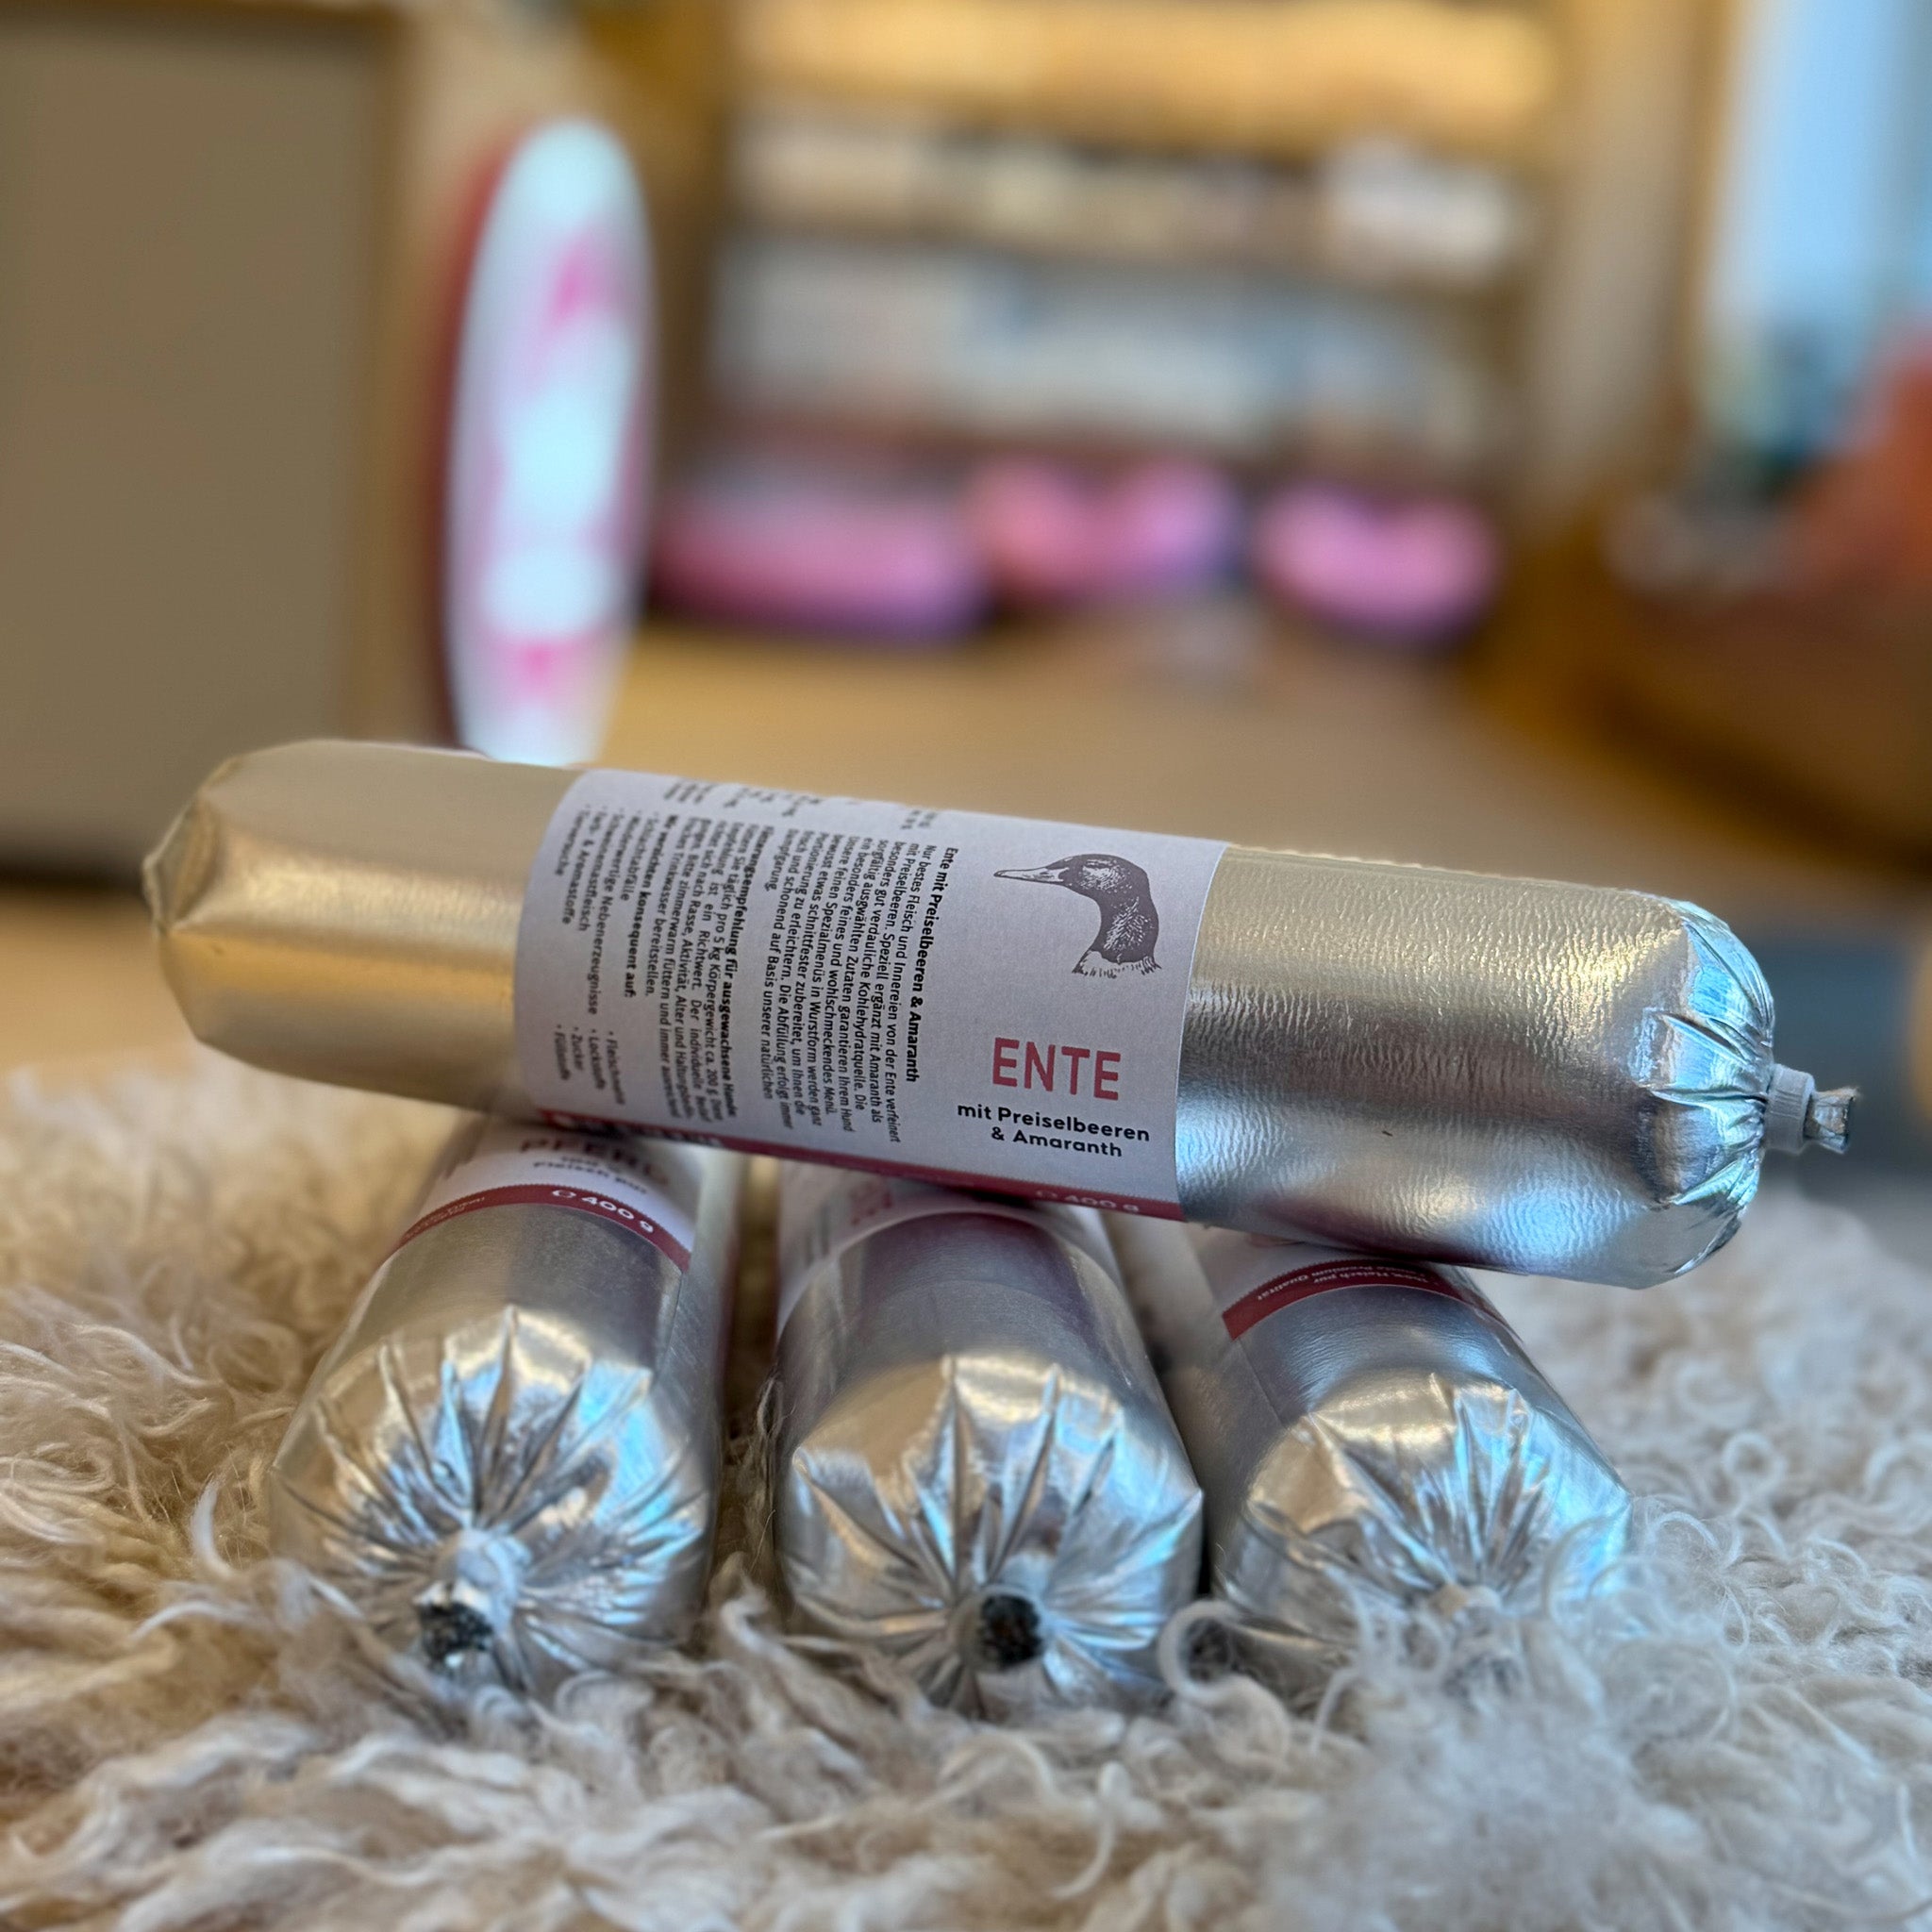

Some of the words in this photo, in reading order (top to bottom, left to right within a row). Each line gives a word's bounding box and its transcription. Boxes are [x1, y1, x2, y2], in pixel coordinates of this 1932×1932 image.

[641, 832, 668, 889] verzichten
[700, 849, 714, 870] sich
[839, 837, 859, 865] Unsere
[860, 838, 873, 850] ein
[863, 840, 889, 880] sorgfältig
[906, 843, 921, 857] mit
[922, 845, 937, 860] Nur
[940, 847, 958, 870] Ente
[731, 857, 746, 872] Sie
[788, 855, 802, 874] und
[794, 833, 829, 895] Portionierung
[843, 852, 873, 903] besonders
[879, 841, 907, 887] besonders
[910, 861, 931, 892] bestes
[932, 872, 948, 891] mit
[562, 850, 590, 924] Aromastoffe
[658, 853, 684, 915] Trinkwasser
[692, 872, 708, 897] nach
[708, 882, 724, 895] ist
[720, 874, 740, 910] täglich
[811, 871, 828, 901] etwas
[828, 867, 848, 899] feinen
[874, 889, 887, 907] gut
[884, 858, 916, 930] Preiselbeeren.
[665, 880, 690, 955] zimmerwarm
[681, 900, 702, 936] Rasse,
[702, 904, 717, 922] ein
[774, 876, 797, 930] schonend
[793, 897, 805, 909] zu
[848, 882, 874, 952] ausgwählten
[900, 894, 921, 932] Fleisch
[626, 891, 652, 970] konsequent
[715, 912, 727, 934] pro
[834, 906, 854, 941] feines
[587, 895, 614, 1015] Nebenerzeugnisse
[645, 918, 667, 996] bereitstellen.
[708, 946, 726, 961] kg
[769, 933, 781, 954] auf
[780, 912, 802, 980] erleichtern.
[797, 904, 820, 979] schnittfester
[812, 902, 838, 983] Spezialmenüs
[830, 943, 842, 967] und
[860, 909, 882, 978] verdauliche
[875, 933, 895, 980] Speziell
[895, 936, 908, 959] und
[912, 894, 942, 991] Preiselbeeren
[674, 939, 693, 992] Aktivität,
[691, 930, 710, 991] Richtwert.
[724, 958, 738, 979] für
[764, 956, 780, 988] Basis
[625, 973, 637, 997] auf:
[660, 958, 676, 999] füttern
[778, 985, 791, 1005] Die
[810, 986, 824, 998] in
[841, 956, 859, 1002] Zutaten
[888, 962, 906, 1020] Innereien
[659, 1003, 672, 1026] und
[675, 995, 687, 1024] Alter
[690, 999, 704, 1021] Der
[704, 963, 721, 1048] Körpergewicht
[761, 991, 773, 1037] unserer
[790, 981, 807, 1045] zubereitet,
[870, 983, 886, 1029] ergänzt
[910, 996, 924, 1008] &
[675, 1026, 687, 1049] und
[720, 981, 732, 1080] ausgewachsene
[774, 1007, 791, 1064] Abfüllung
[808, 1001, 822, 1063] Wurstform
[823, 970, 840, 1084] wohlschmeckendes
[838, 1005, 851, 1073] garantieren
[851, 981, 871, 1091] Kohlehydratquelle.
[870, 1032, 883, 1052] mit
[886, 1024, 896, 1045] von
[659, 1027, 672, 1063] immer
[690, 1028, 707, 1091] individuelle
[705, 1051, 715, 1065] ca.
[791, 1048, 801, 1067] um
[885, 1049, 898, 1070] der
[906, 1010, 922, 1082] Amaranth
[706, 1068, 719, 1087] 200
[760, 1039, 777, 1099] natürlichen
[775, 1065, 790, 1100] erfolgt
[791, 1069, 805, 1098] Ihnen
[807, 1065, 821, 1104] werden
[869, 1054, 882, 1107] Amaranth
[885, 1072, 897, 1096] Ente
[992, 1037, 1121, 1101] ENTE
[794, 1100, 808, 1115] die
[838, 1075, 851, 1107] Ihrem
[854, 1094, 868, 1110] Die
[807, 1105, 822, 1126] ganz
[841, 1108, 855, 1132] Hund
[871, 1108, 884, 1123] als
[886, 1098, 901, 1142] verfeinert
[958, 1104, 991, 1120] mit
[998, 1107, 1150, 1141] Preiselbeeren
[991, 1126, 1005, 1141] &
[1012, 1130, 1123, 1157] Amaranth
[581, 1196, 635, 1220] 400
[640, 1220, 654, 1233] g
